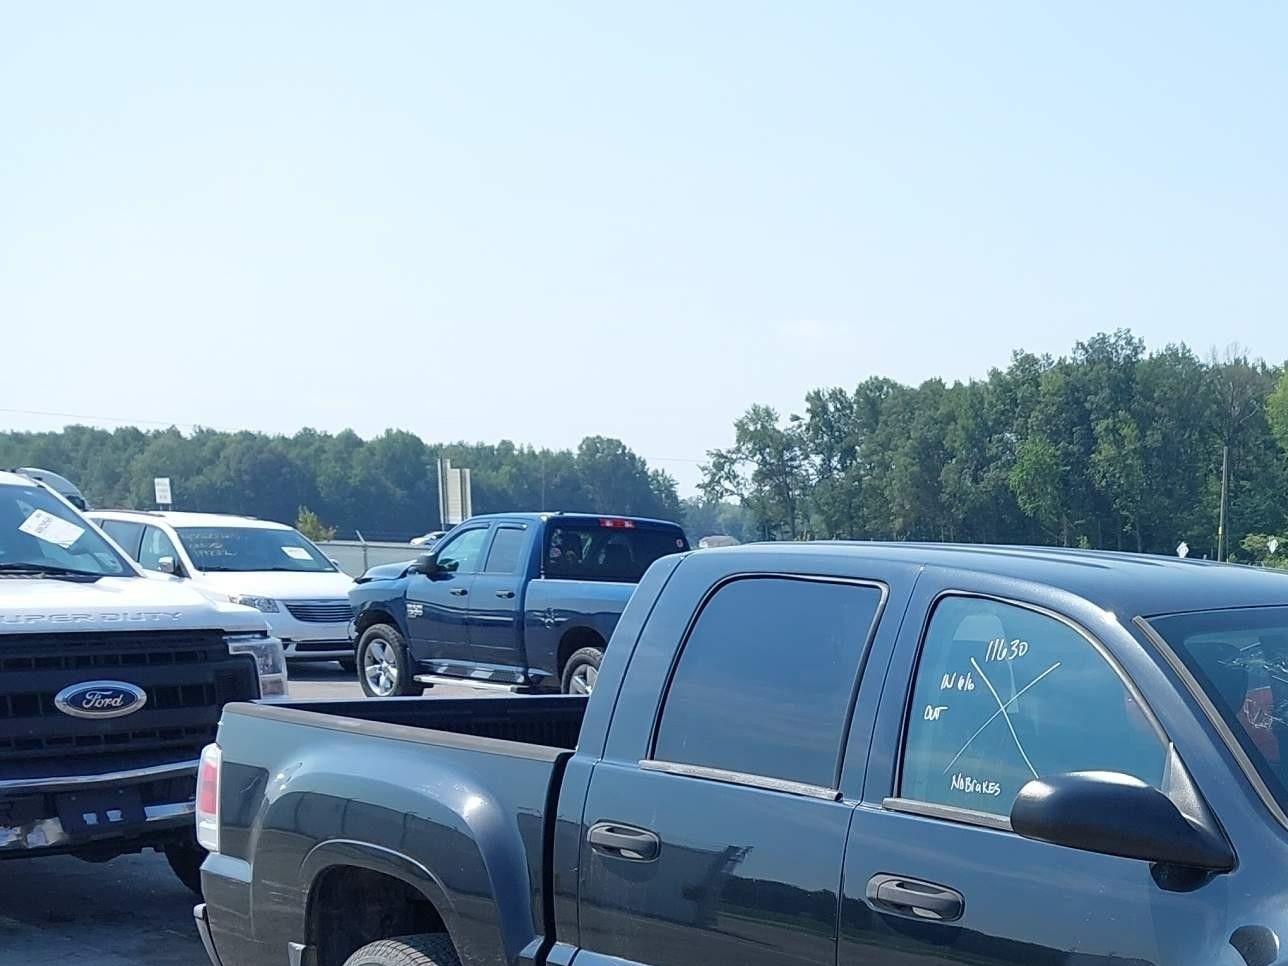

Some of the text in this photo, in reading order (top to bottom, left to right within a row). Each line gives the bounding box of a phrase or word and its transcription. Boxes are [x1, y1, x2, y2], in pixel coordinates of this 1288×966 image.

[0, 611, 184, 625] UPER DUTY
[985, 638, 1029, 662] 11630
[82, 690, 124, 709] Ford
[924, 705, 949, 721] OUT
